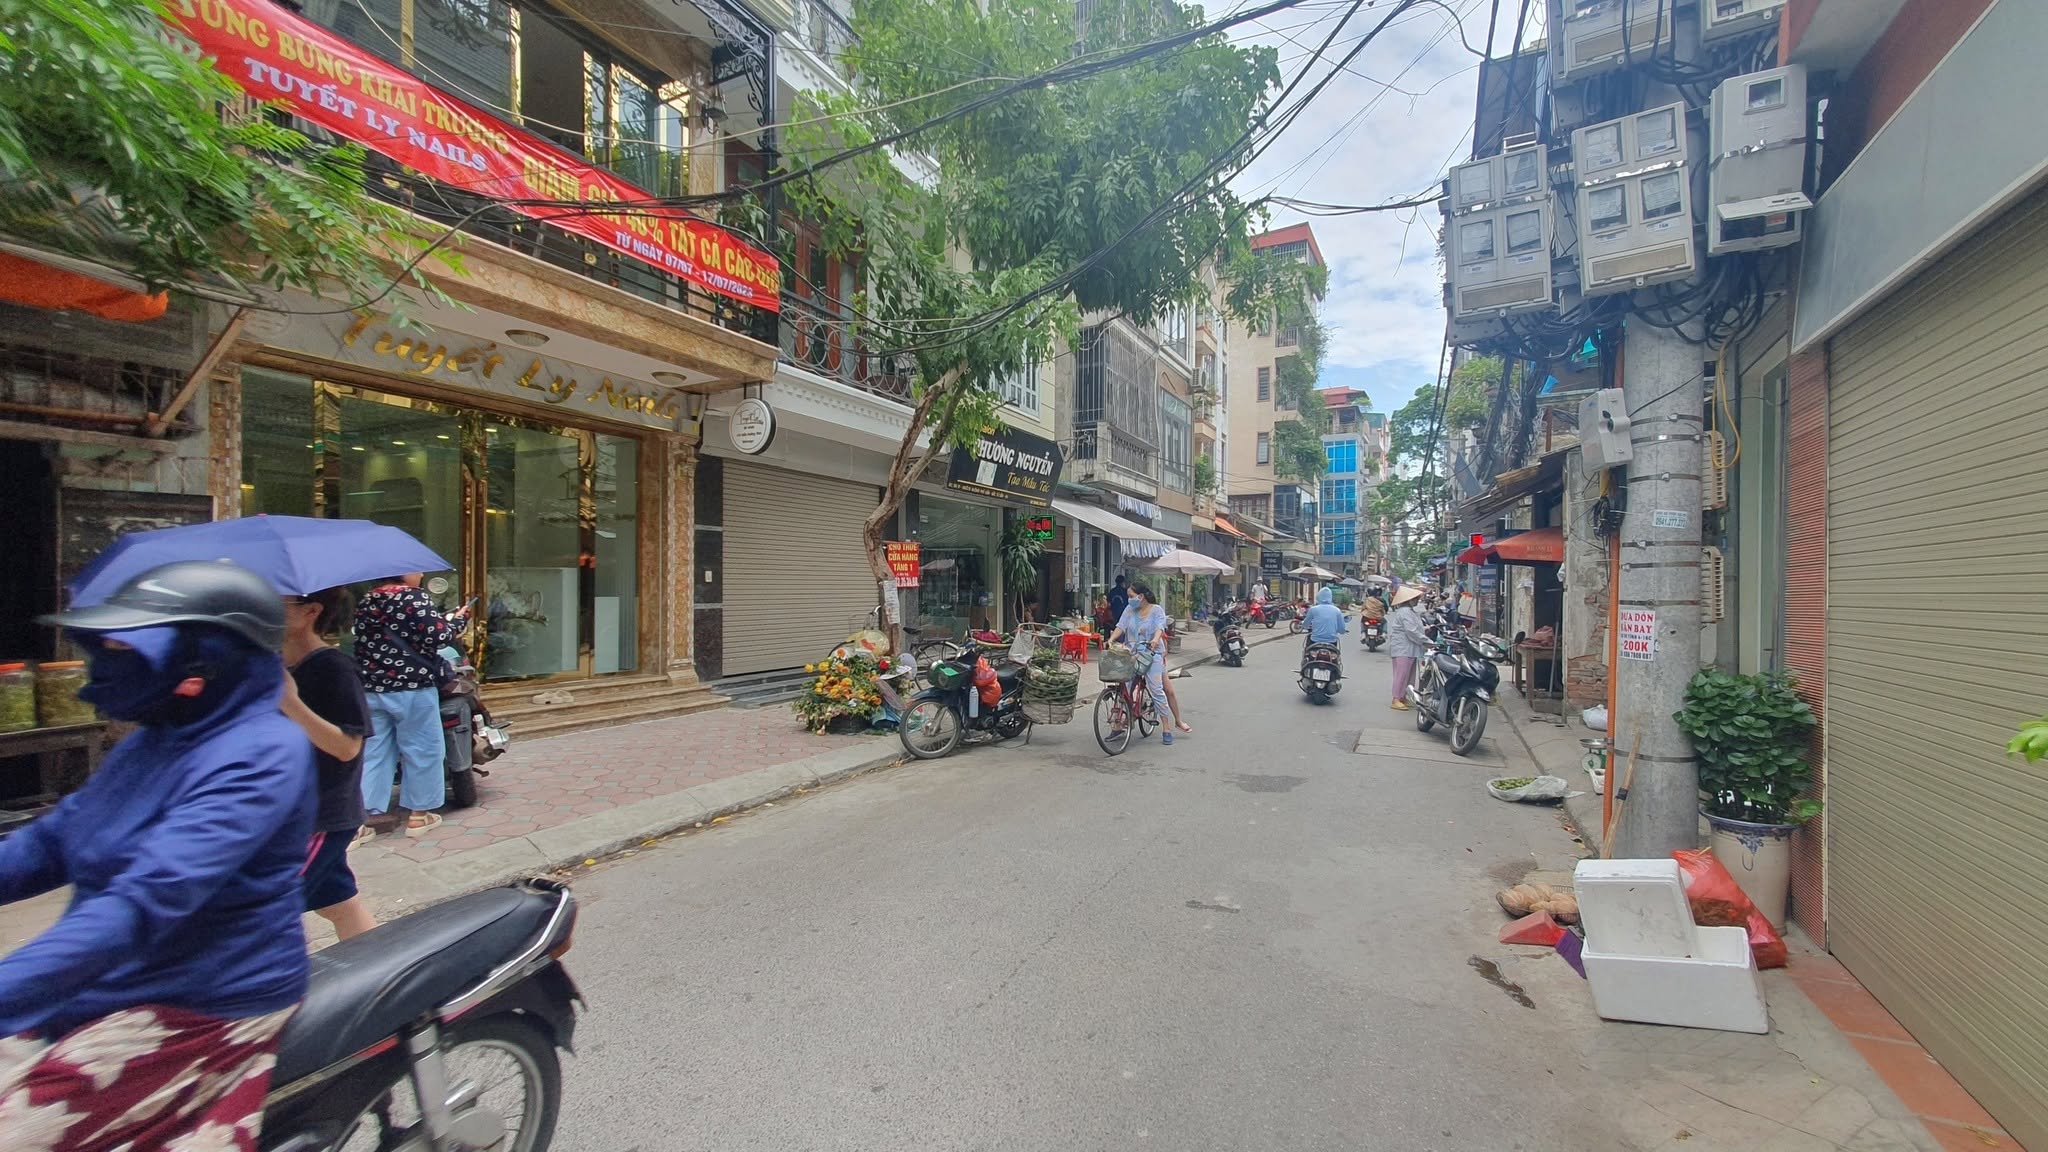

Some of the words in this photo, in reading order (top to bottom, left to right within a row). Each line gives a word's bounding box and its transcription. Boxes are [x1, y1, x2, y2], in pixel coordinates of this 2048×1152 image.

[244, 56, 358, 119] TUYẾT
[365, 107, 401, 137] LY
[407, 126, 488, 172] NAILS
[358, 69, 417, 117] KHAI
[701, 233, 721, 271] CẢ
[632, 238, 663, 263] NGÀY
[514, 357, 578, 404] Ly
[586, 375, 681, 420] Nails
[1623, 640, 1649, 652] 200K
[1634, 624, 1652, 634] BAY
